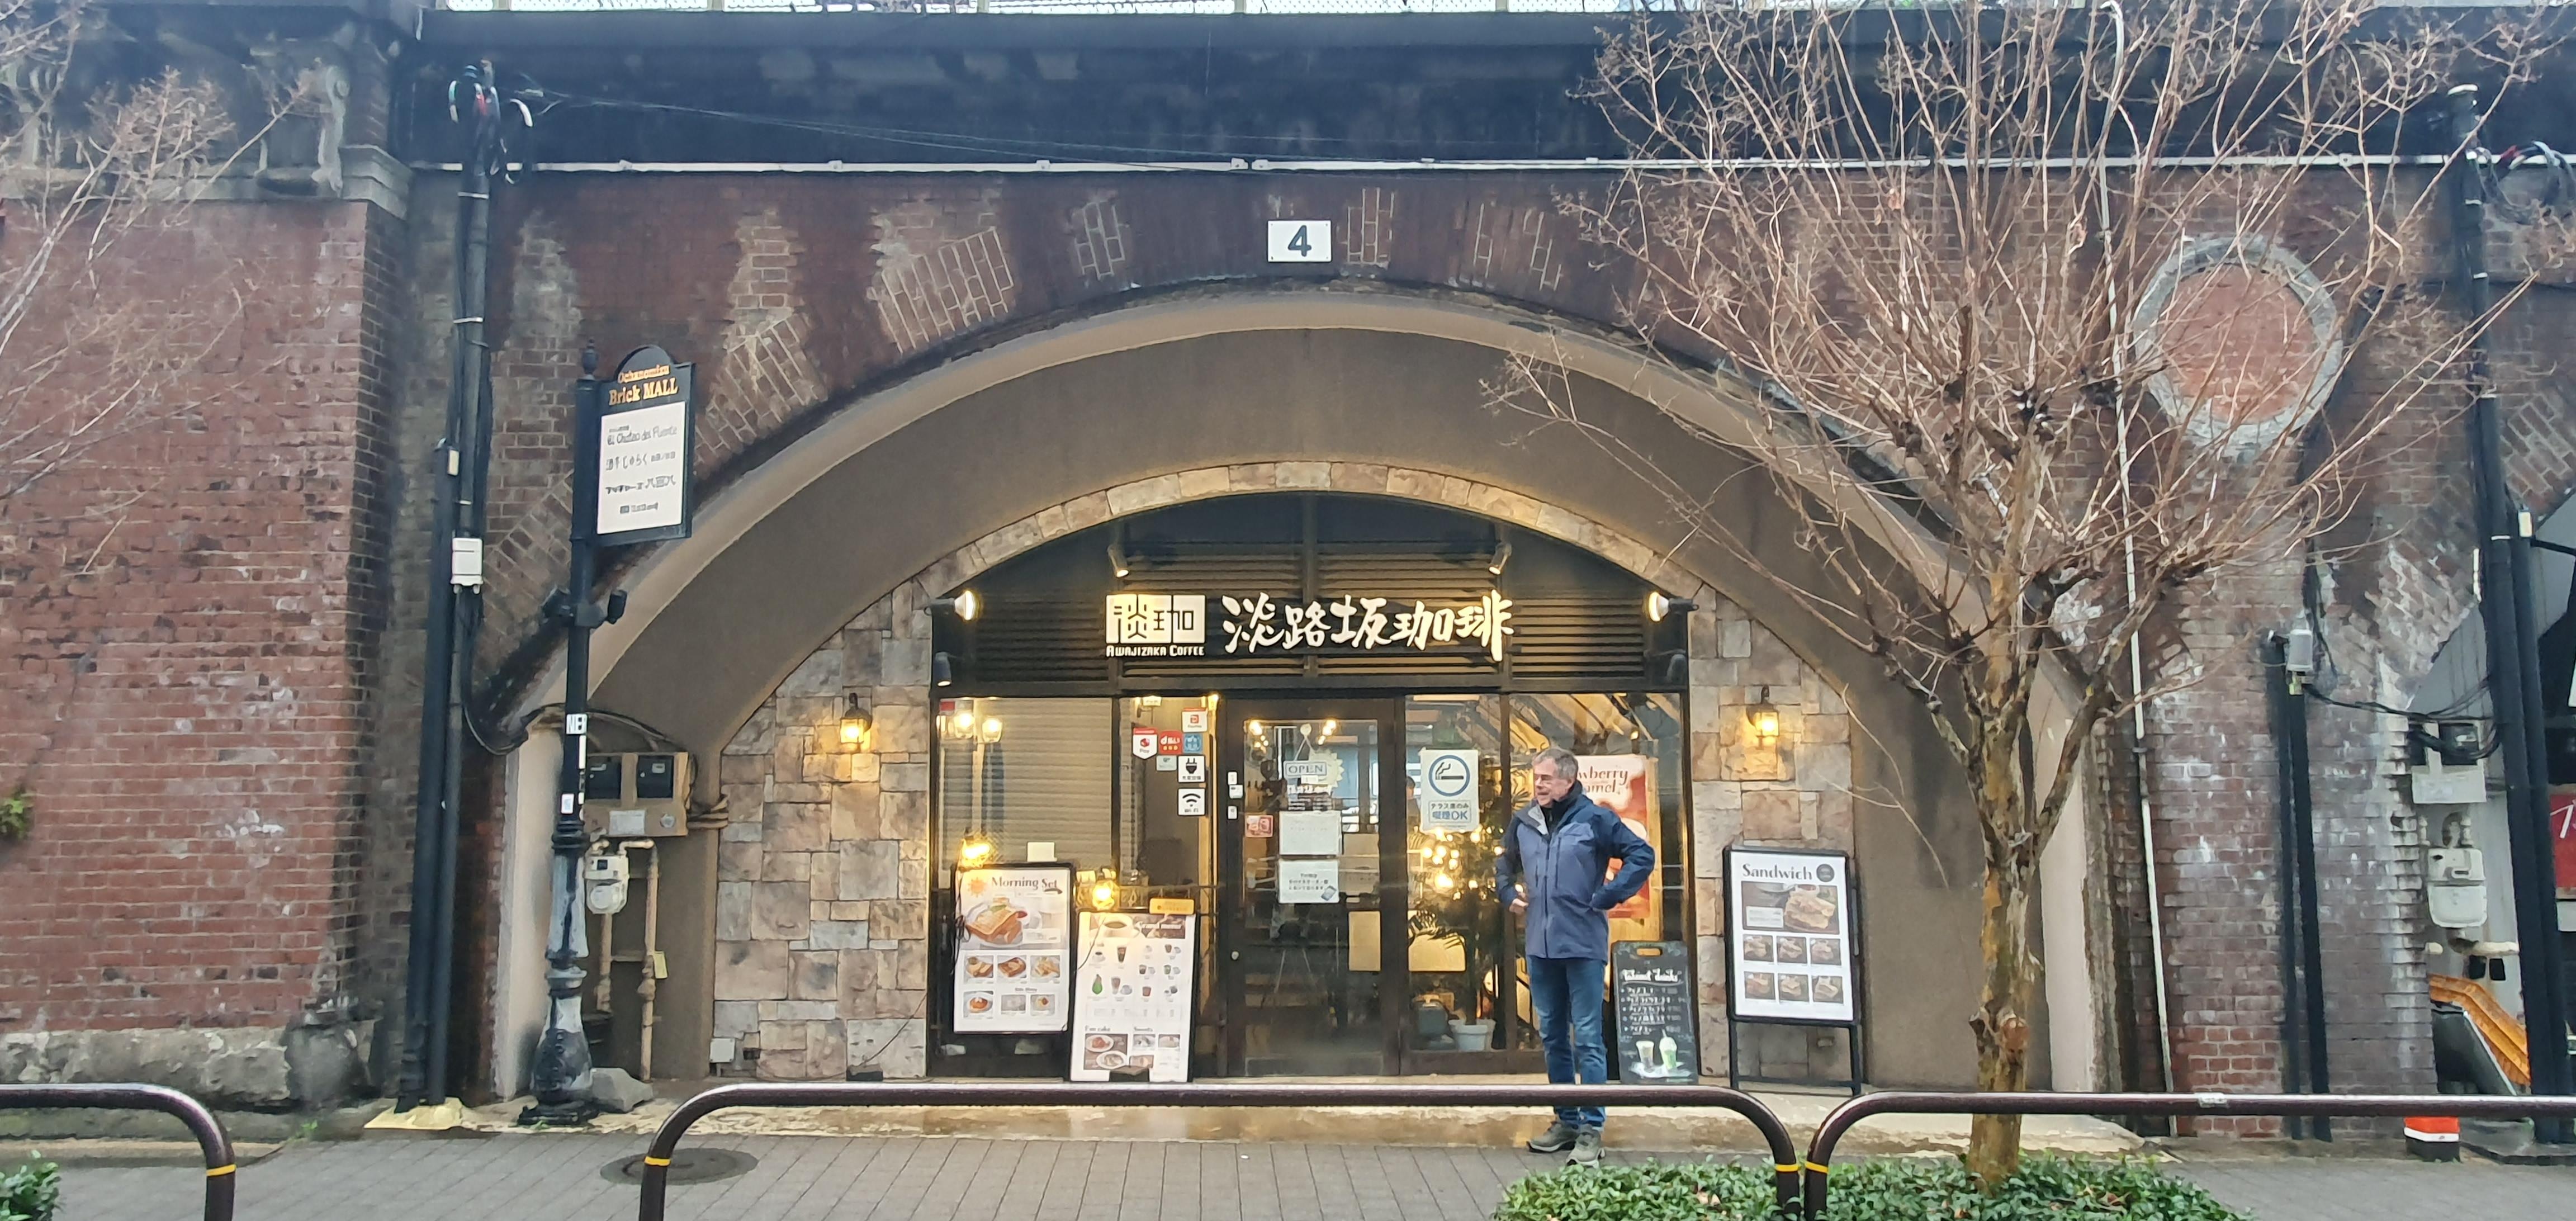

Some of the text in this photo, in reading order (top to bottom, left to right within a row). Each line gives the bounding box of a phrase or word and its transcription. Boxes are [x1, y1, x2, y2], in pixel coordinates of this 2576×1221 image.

[1287, 225, 1312, 257] 4
[609, 377, 679, 406] Brick MALL
[1221, 589, 1514, 662] 淡路坂珈琲
[1288, 765, 1323, 774] OPEN
[1578, 765, 1628, 785] wberry
[1742, 863, 1813, 881] Sandwich
[992, 876, 1058, 891] Morning Set
